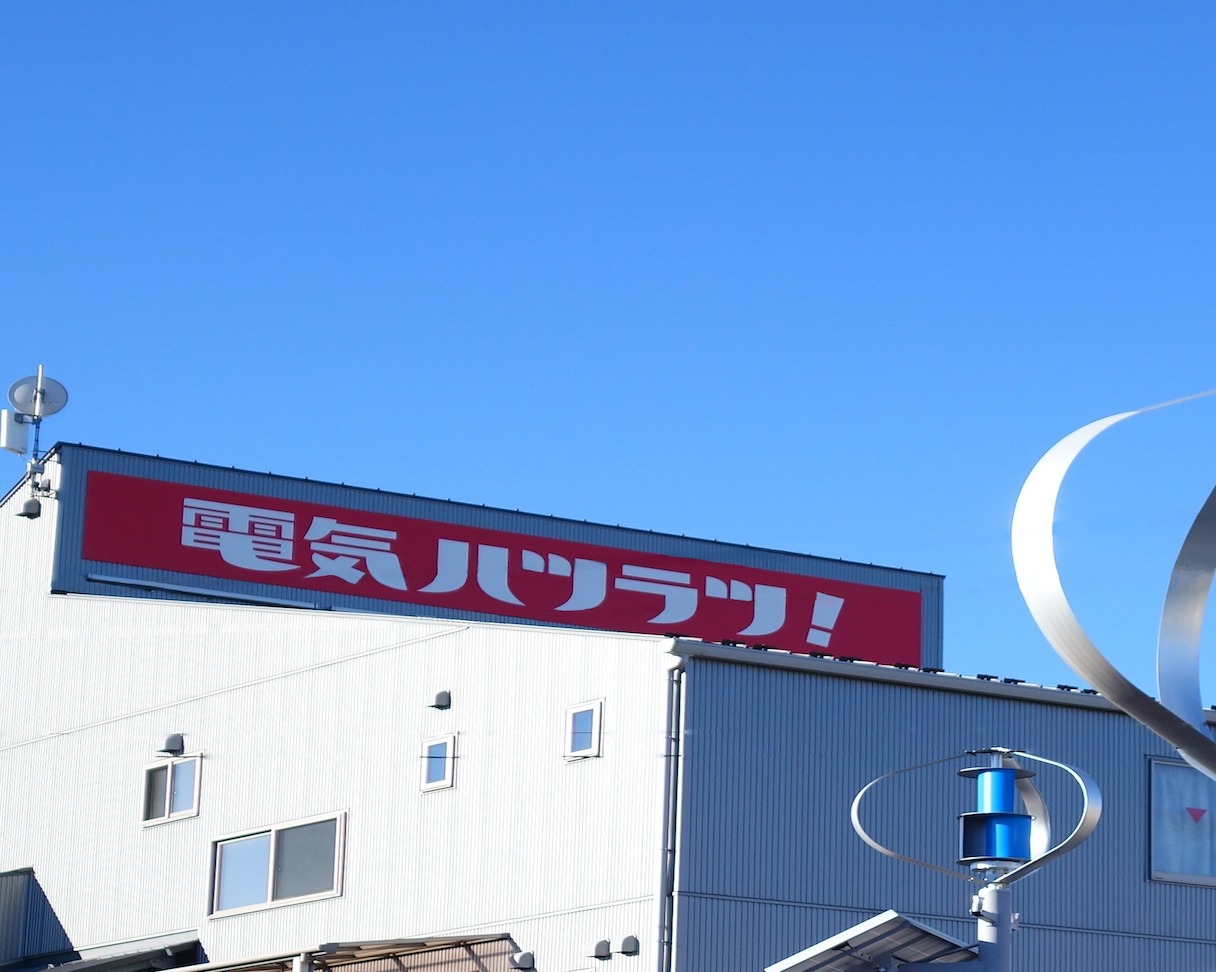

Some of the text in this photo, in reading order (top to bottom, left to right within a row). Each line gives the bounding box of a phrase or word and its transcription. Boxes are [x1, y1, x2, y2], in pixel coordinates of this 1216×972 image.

[181, 497, 845, 648] 電気ハツラツ!
